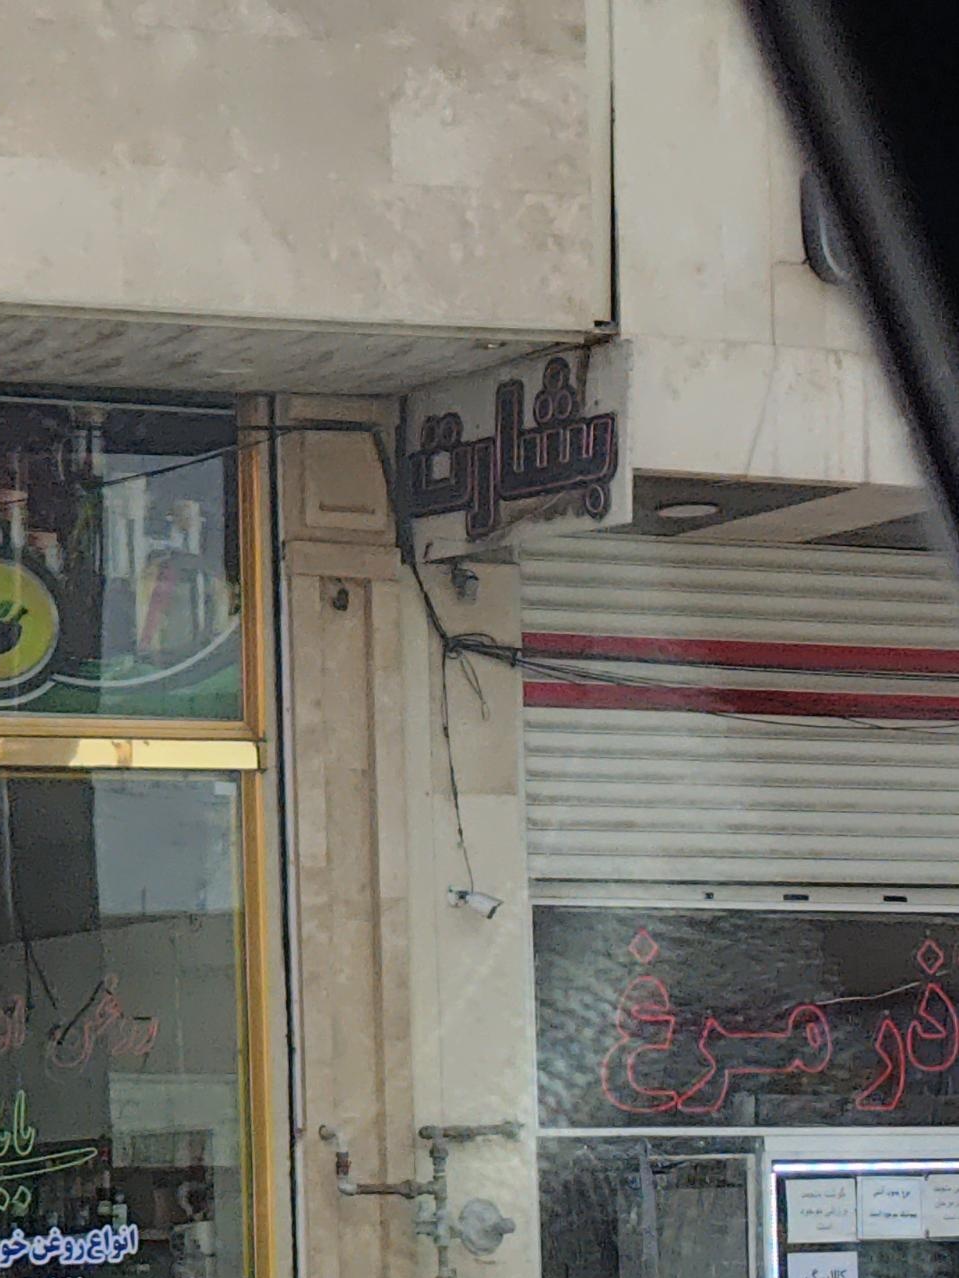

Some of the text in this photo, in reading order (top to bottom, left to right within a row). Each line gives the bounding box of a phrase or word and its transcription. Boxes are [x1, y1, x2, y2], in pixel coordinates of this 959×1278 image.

[600, 928, 959, 1113] مرغ ذر
[30, 1227, 87, 1266] روغن
[87, 1224, 139, 1264] انواع
